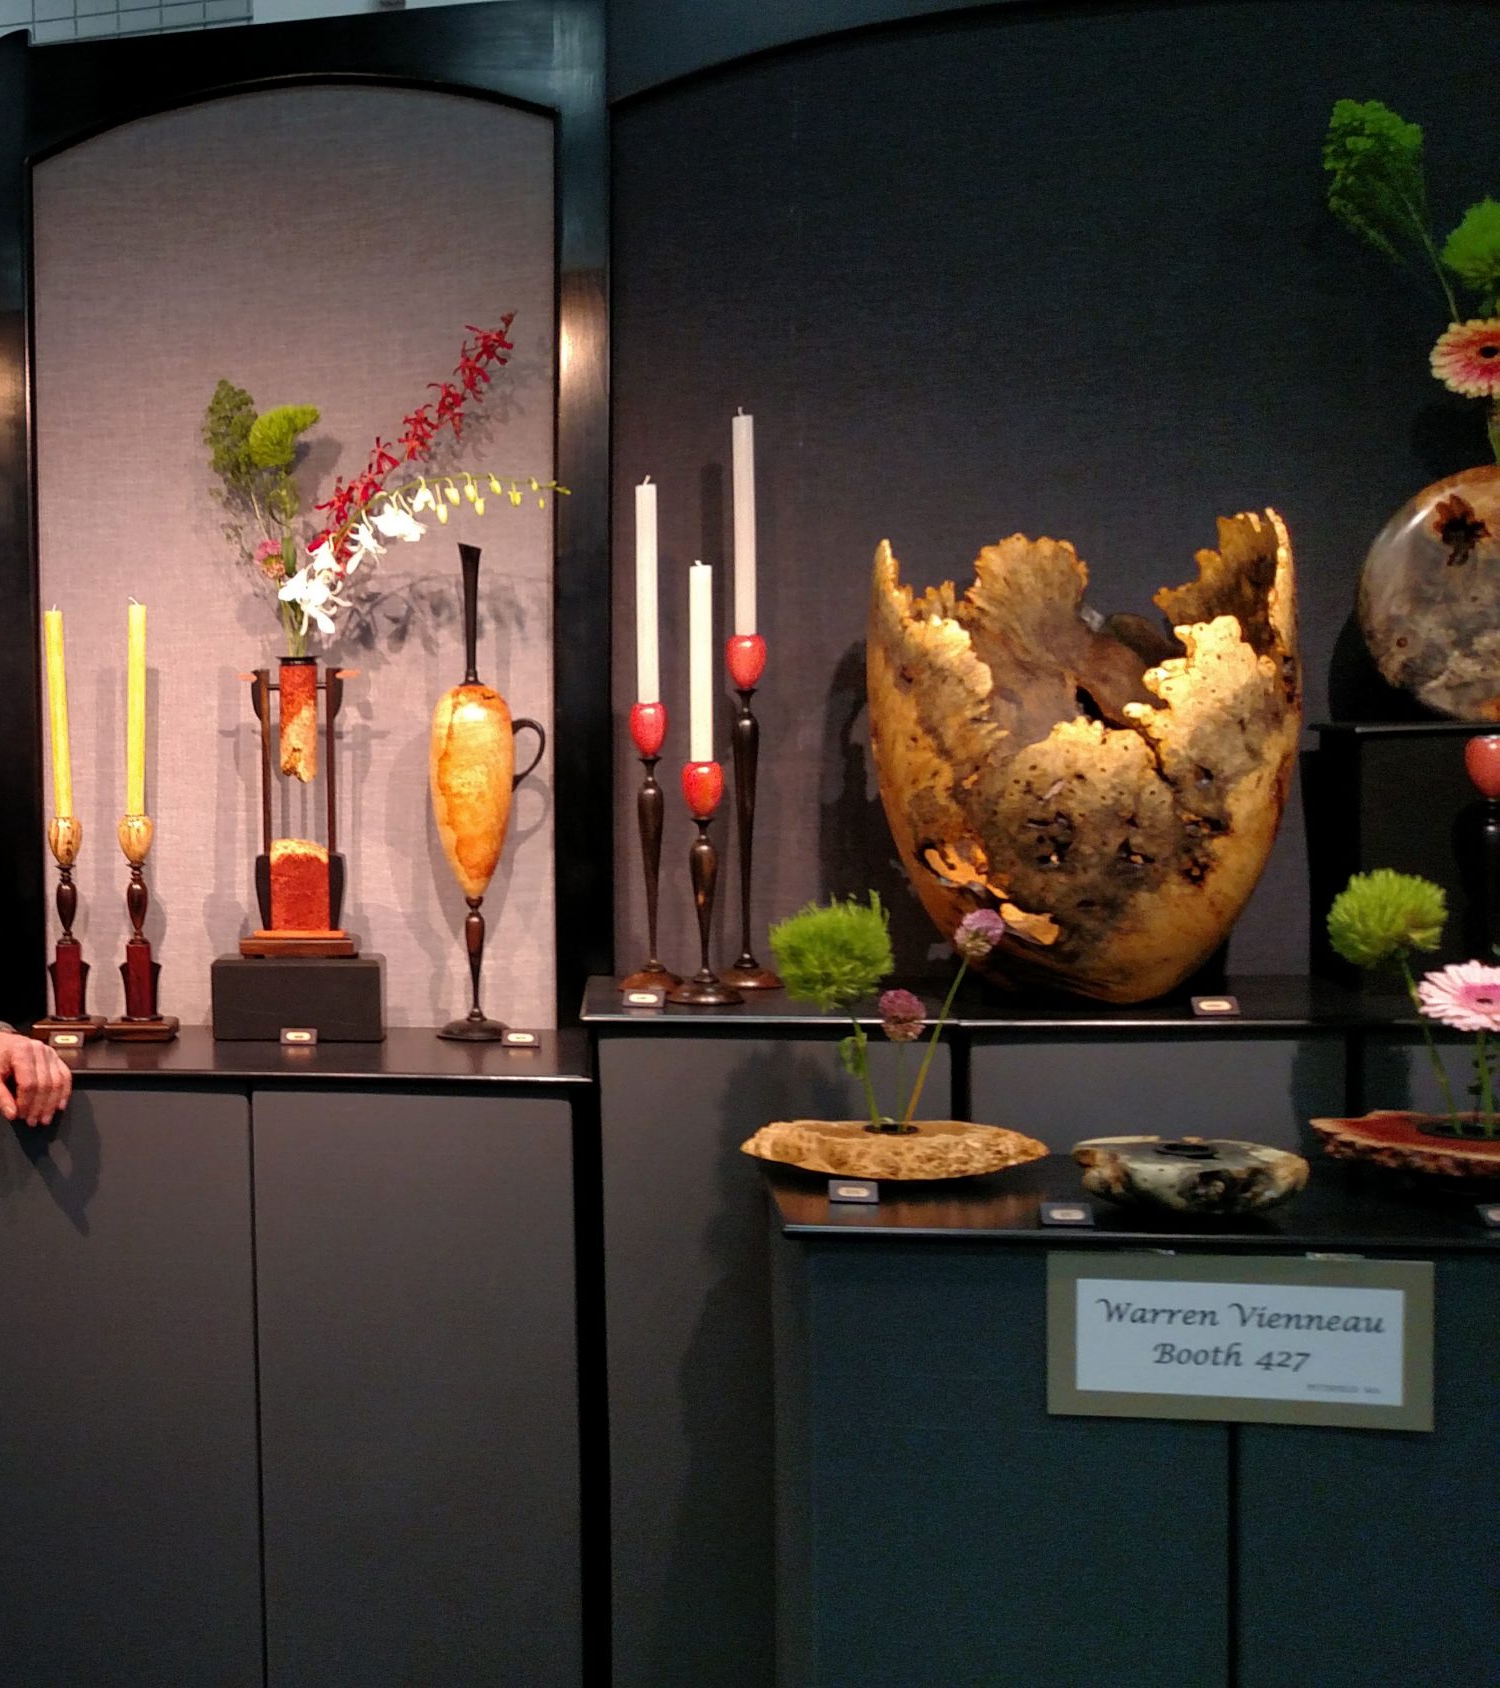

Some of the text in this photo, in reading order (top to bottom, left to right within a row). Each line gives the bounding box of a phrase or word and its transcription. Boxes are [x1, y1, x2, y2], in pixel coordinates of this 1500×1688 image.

[1095, 1298, 1386, 1334] Warren Vienneau
[1152, 1343, 1311, 1372] Booth 427
